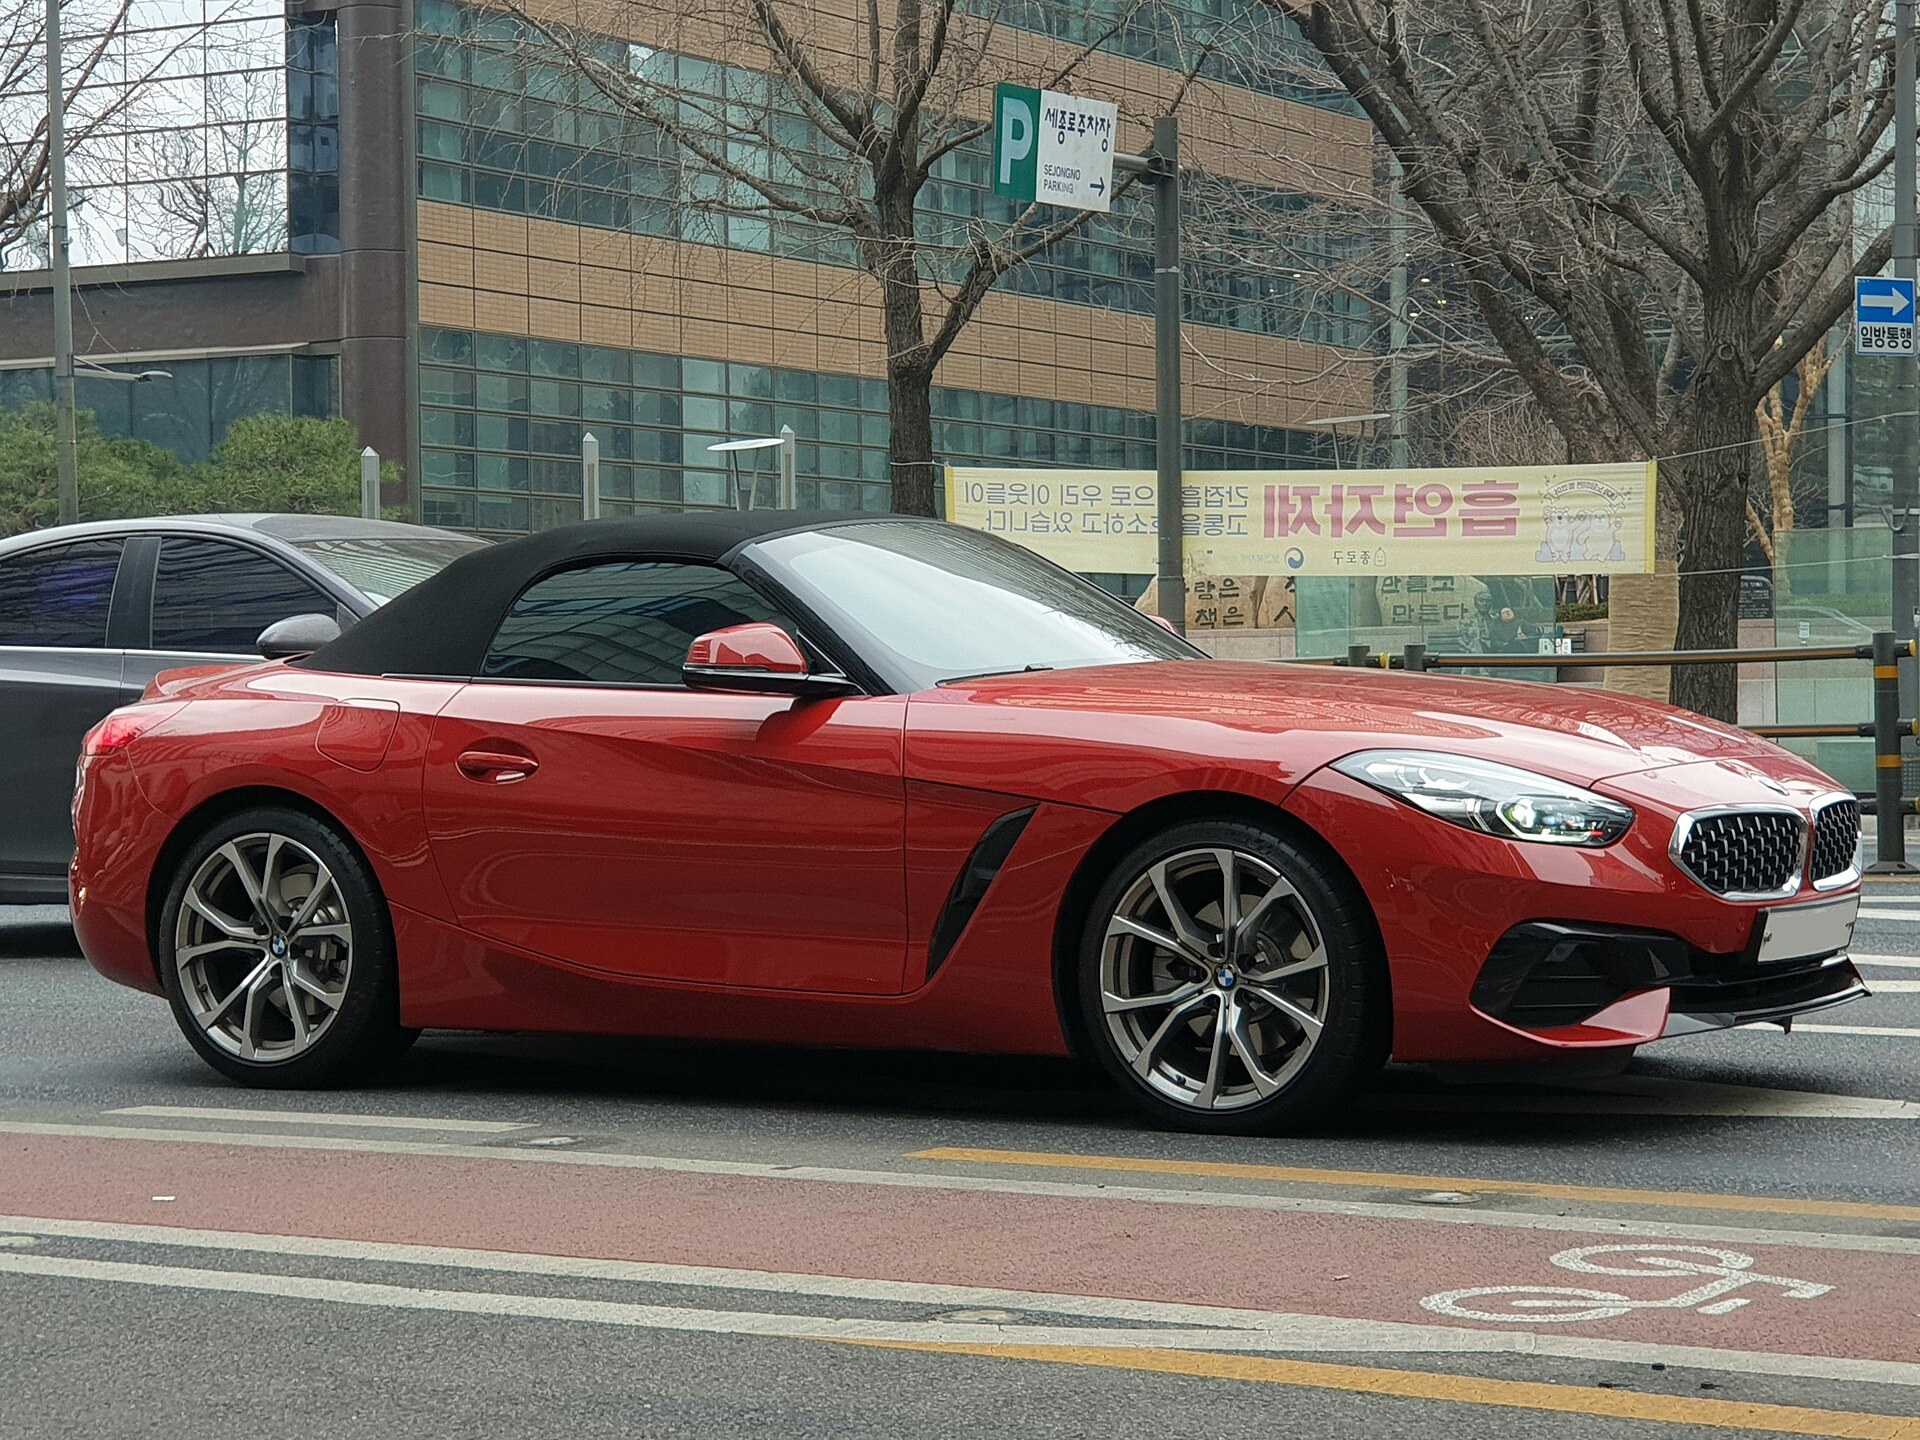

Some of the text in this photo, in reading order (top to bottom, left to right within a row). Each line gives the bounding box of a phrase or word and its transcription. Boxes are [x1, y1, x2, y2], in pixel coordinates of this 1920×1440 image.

[1000, 97, 1033, 184] P
[1043, 164, 1081, 181] SEJONGNO
[1043, 179, 1074, 194] PARKING
[1861, 325, 1912, 349] 일방통행
[1185, 578, 1240, 600] 람은
[1195, 606, 1244, 629] 책은
[1392, 602, 1469, 625] 만든다
